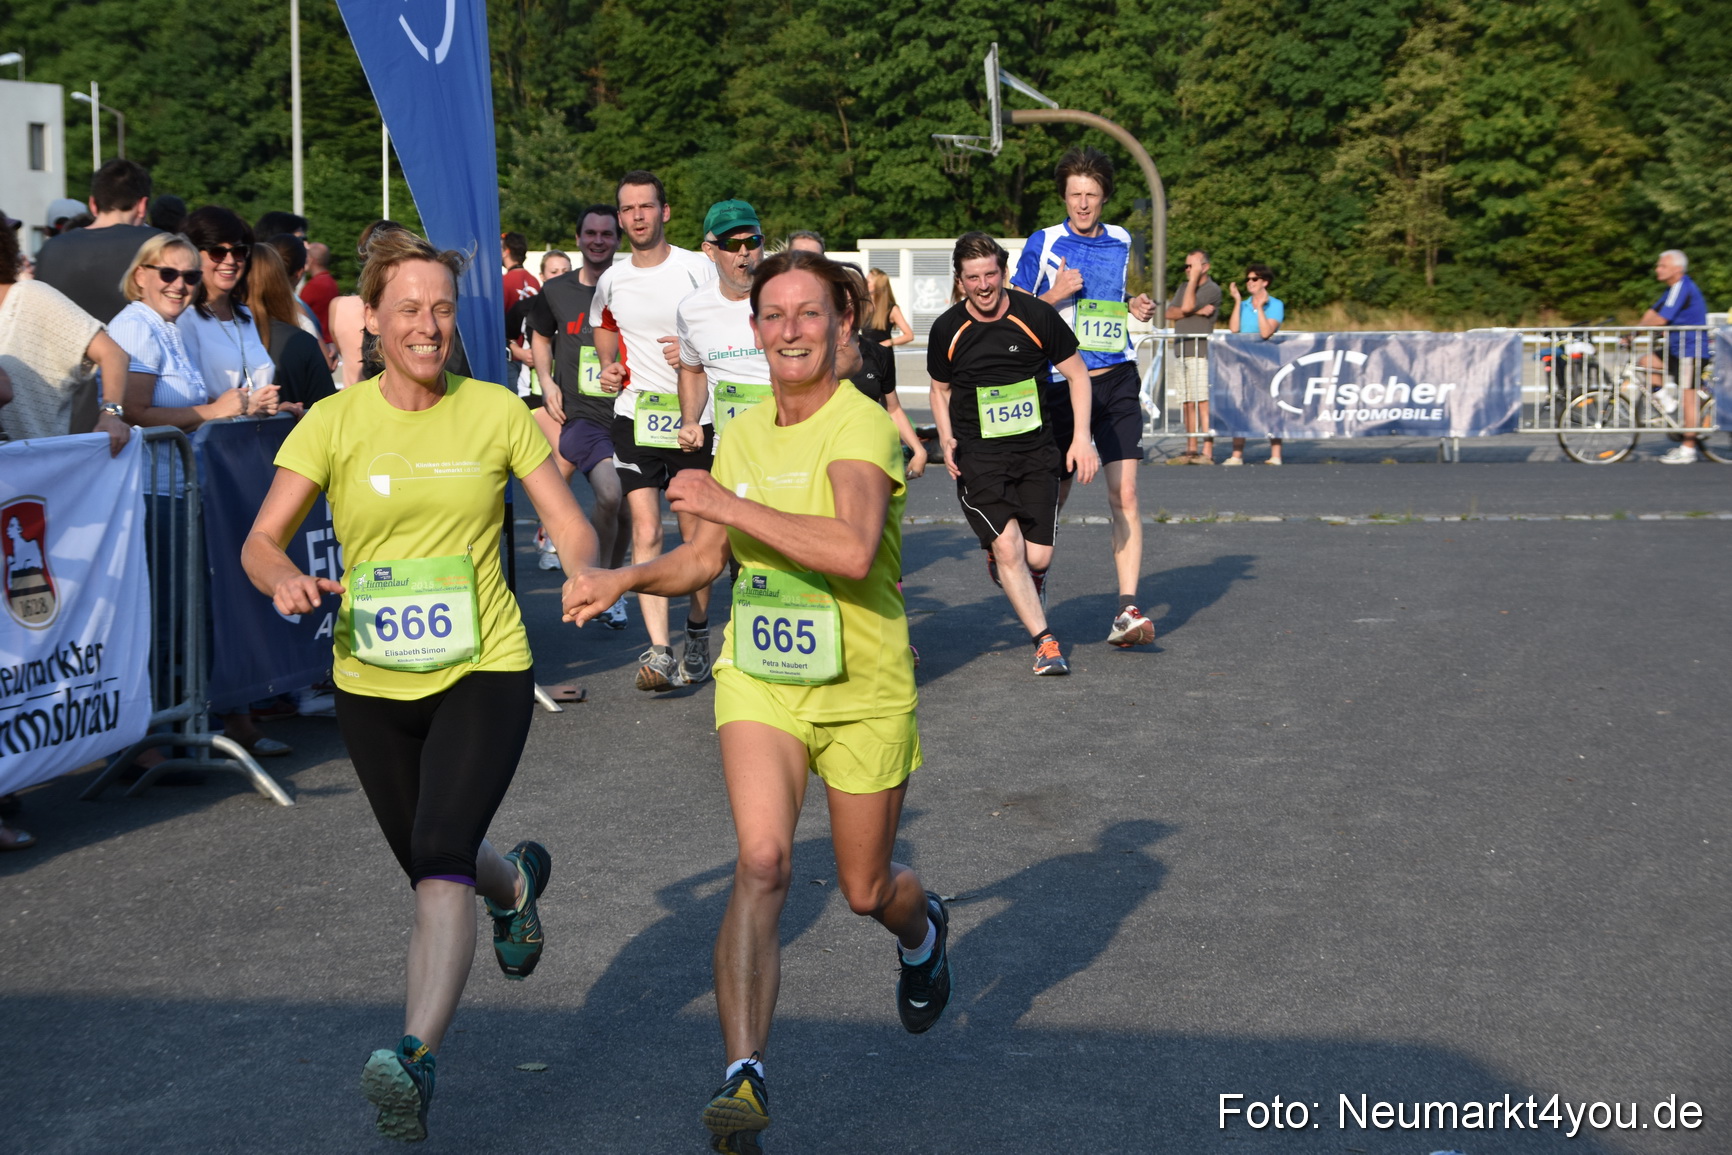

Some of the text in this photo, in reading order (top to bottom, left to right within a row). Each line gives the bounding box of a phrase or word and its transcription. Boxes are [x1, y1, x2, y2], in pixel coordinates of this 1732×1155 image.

[1082, 320, 1122, 338] 1125
[1303, 376, 1456, 405] Fischer
[986, 401, 1034, 423] 1549
[1317, 408, 1444, 422] AUTOMOBILE
[647, 414, 683, 433] 824
[366, 577, 410, 588] firmenlauf
[745, 585, 780, 598] firmenlauf
[19, 597, 49, 618] 1628
[375, 602, 453, 642] 666
[752, 614, 817, 655] 665
[385, 647, 446, 657] Elisabeth Simon
[0, 639, 103, 699] eumarkter
[762, 659, 808, 669] Petra Naubert
